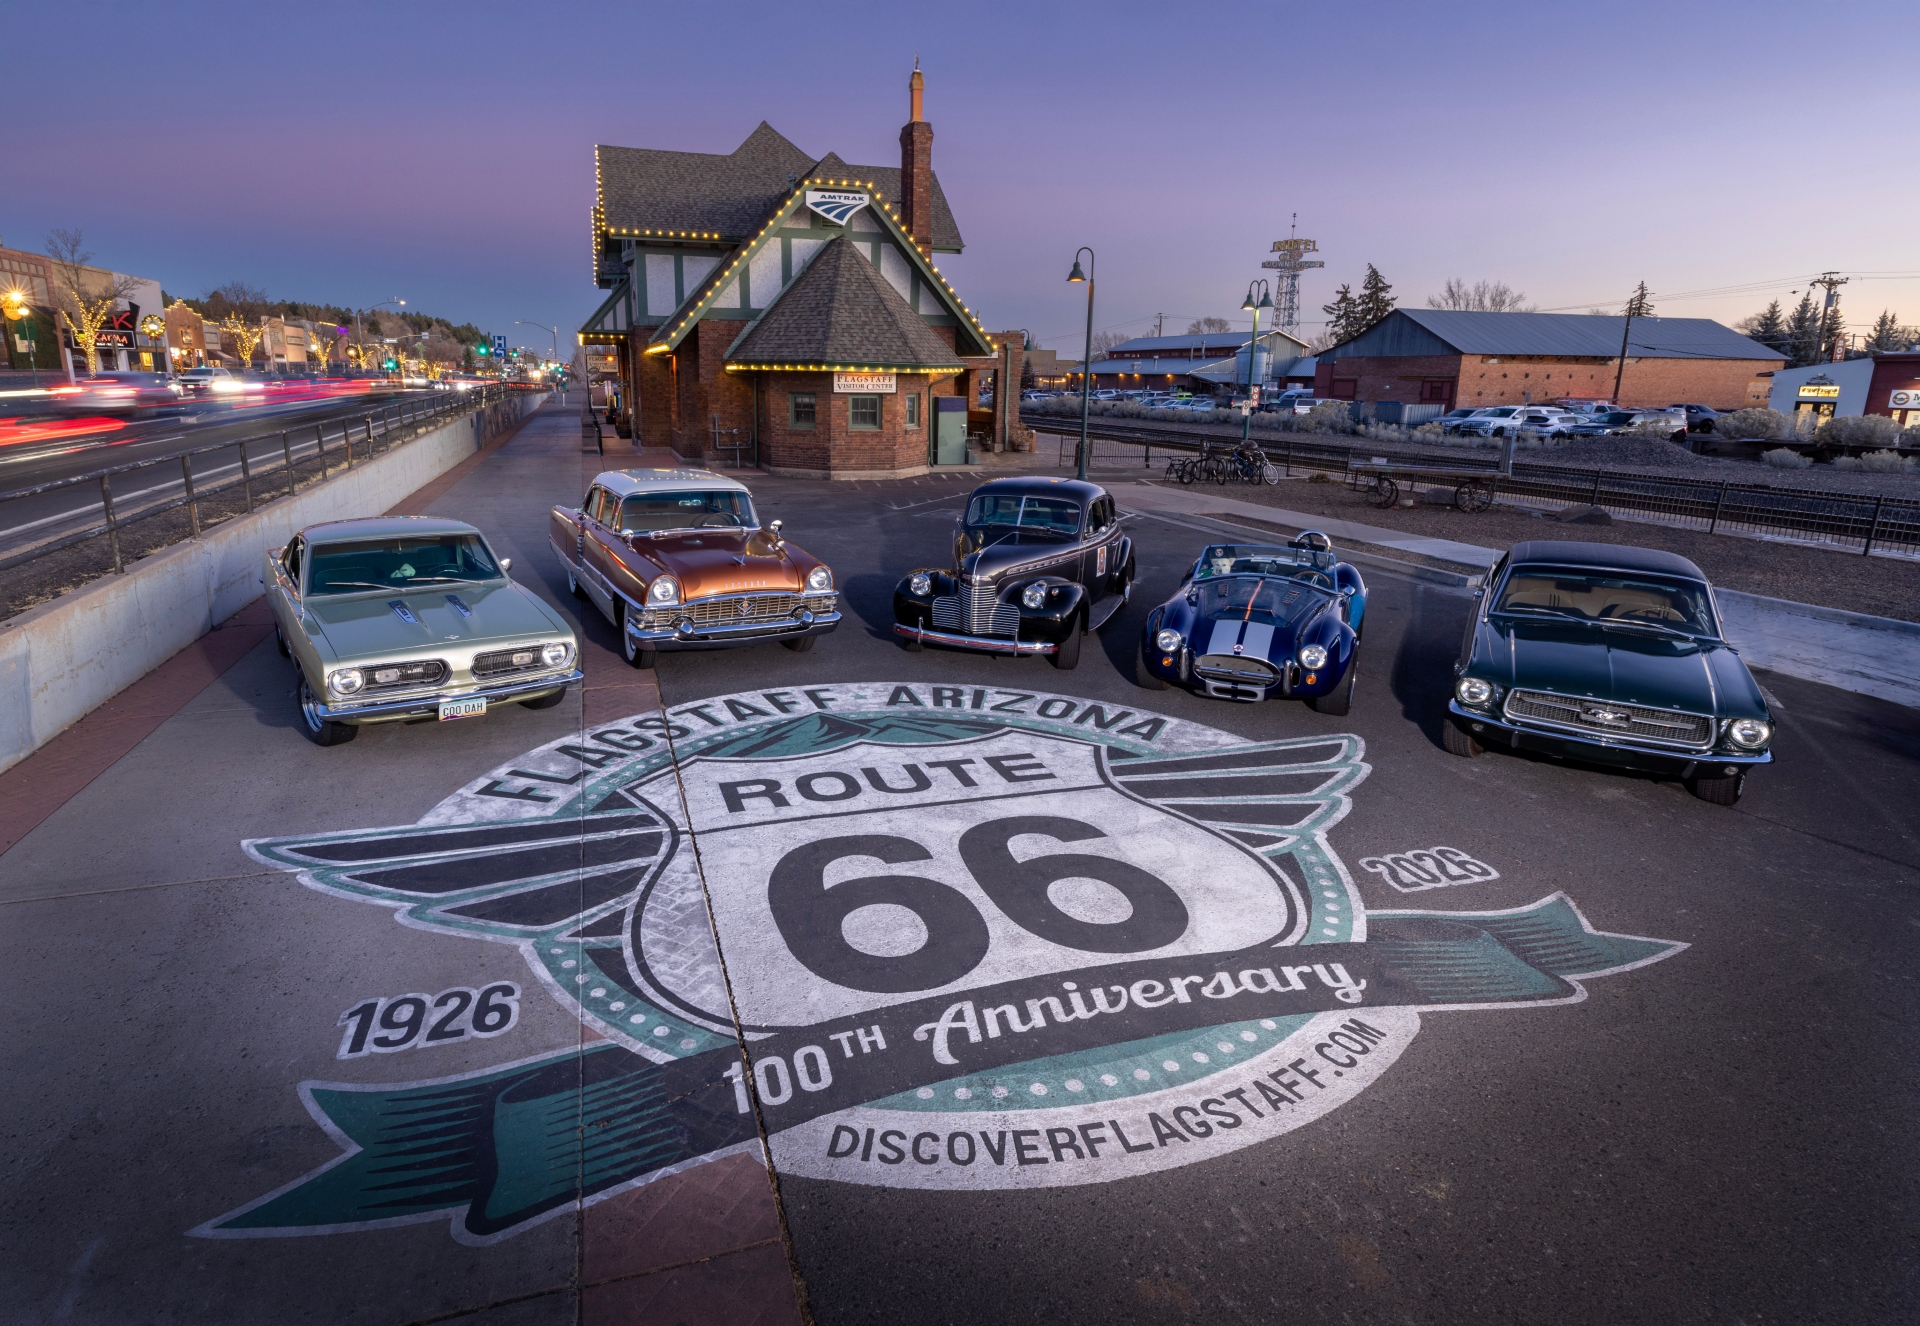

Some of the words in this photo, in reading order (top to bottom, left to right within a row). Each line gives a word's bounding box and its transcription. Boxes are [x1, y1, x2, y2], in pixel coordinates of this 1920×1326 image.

[820, 194, 865, 202] AMTRAK
[1275, 239, 1318, 252] MOTEL
[837, 374, 893, 383] FLAGSTAFF
[866, 383, 893, 391] CENTER
[464, 702, 483, 714] DAH
[474, 687, 840, 803] FLAGSTAFF
[885, 685, 1169, 742] ARIZONA
[719, 752, 1057, 813] ROUTE
[1362, 847, 1496, 891] 2026
[767, 815, 1189, 993] 66
[342, 983, 519, 1057] 1926
[722, 1041, 834, 1116] 100
[830, 1024, 888, 1061] TH
[913, 960, 1367, 1066] Anniversary
[826, 1017, 1389, 1167] DISCOVERFLAGSTAFF.COM
